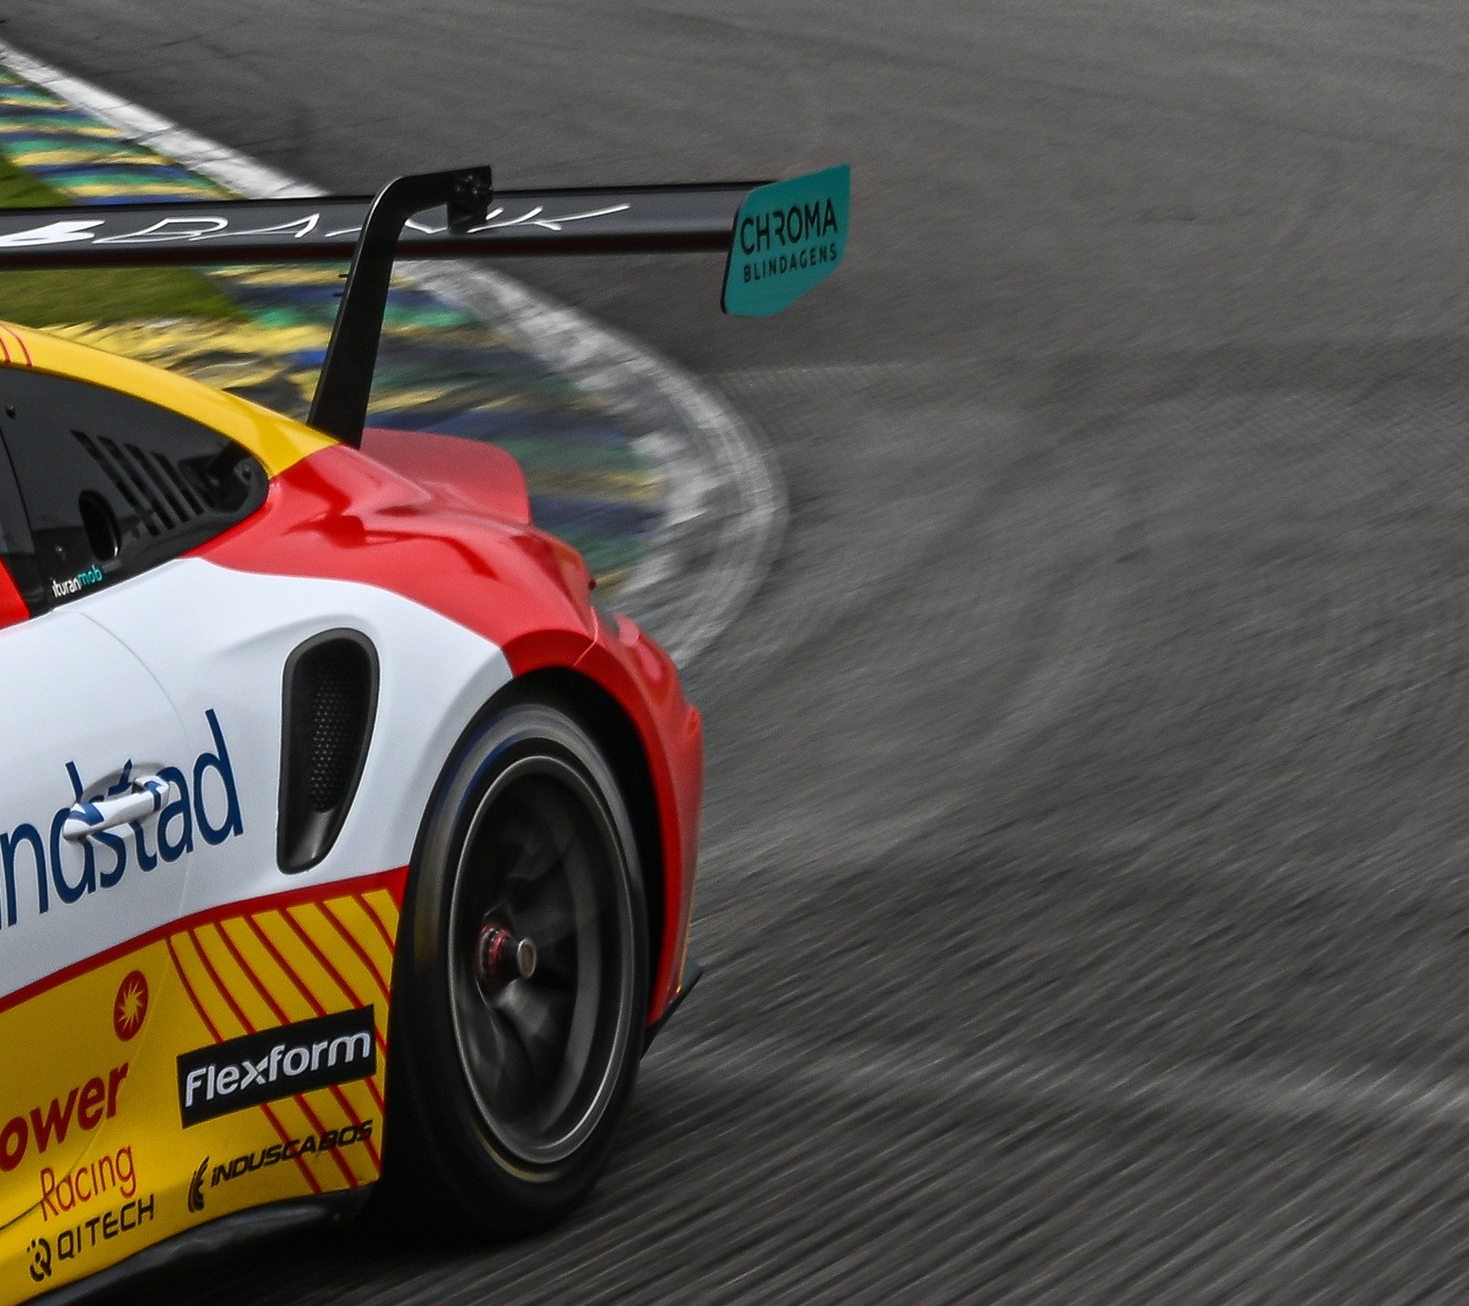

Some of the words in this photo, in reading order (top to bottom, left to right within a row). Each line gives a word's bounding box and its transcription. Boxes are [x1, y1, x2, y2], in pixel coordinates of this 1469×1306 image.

[740, 199, 838, 255] CHROMA
[744, 243, 838, 283] BLINDAGENS
[185, 1032, 371, 1108] Flexform
[40, 1146, 137, 1222] Racing
[210, 1120, 373, 1188] INDUSCABOS
